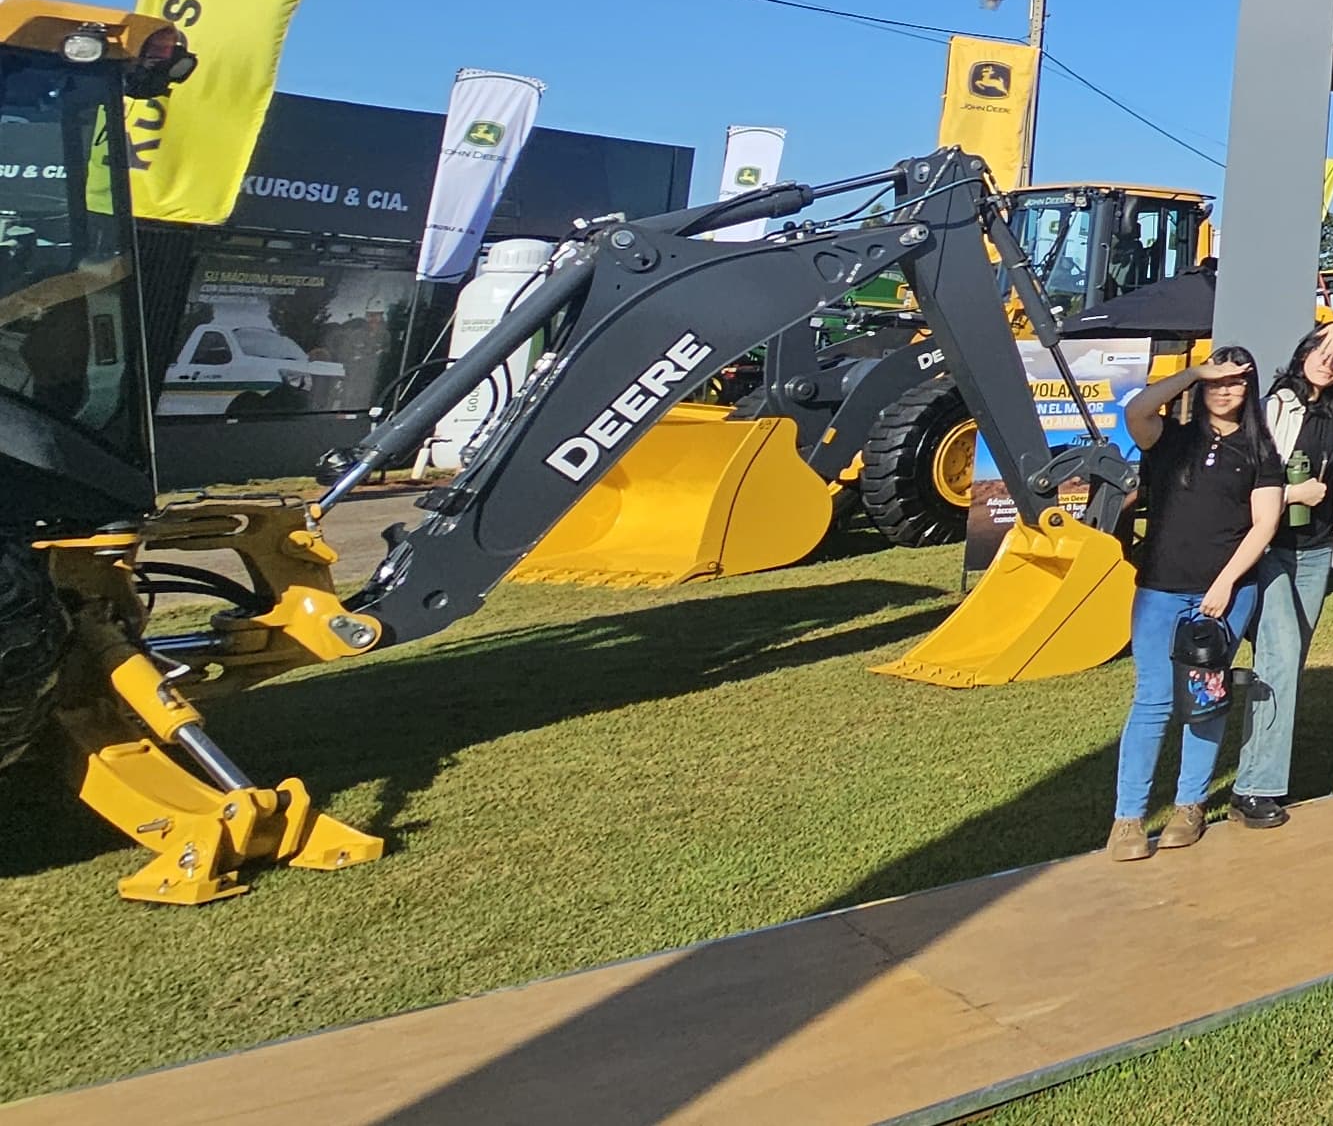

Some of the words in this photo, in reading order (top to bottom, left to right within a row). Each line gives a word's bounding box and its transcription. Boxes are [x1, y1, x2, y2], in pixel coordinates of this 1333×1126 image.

[445, 148, 472, 158] OHN
[242, 176, 339, 203] KUROSU
[343, 188, 360, 207] &
[367, 190, 409, 212] CIA.
[1031, 382, 1100, 398] VOLAOS
[545, 332, 713, 482] DEERE
